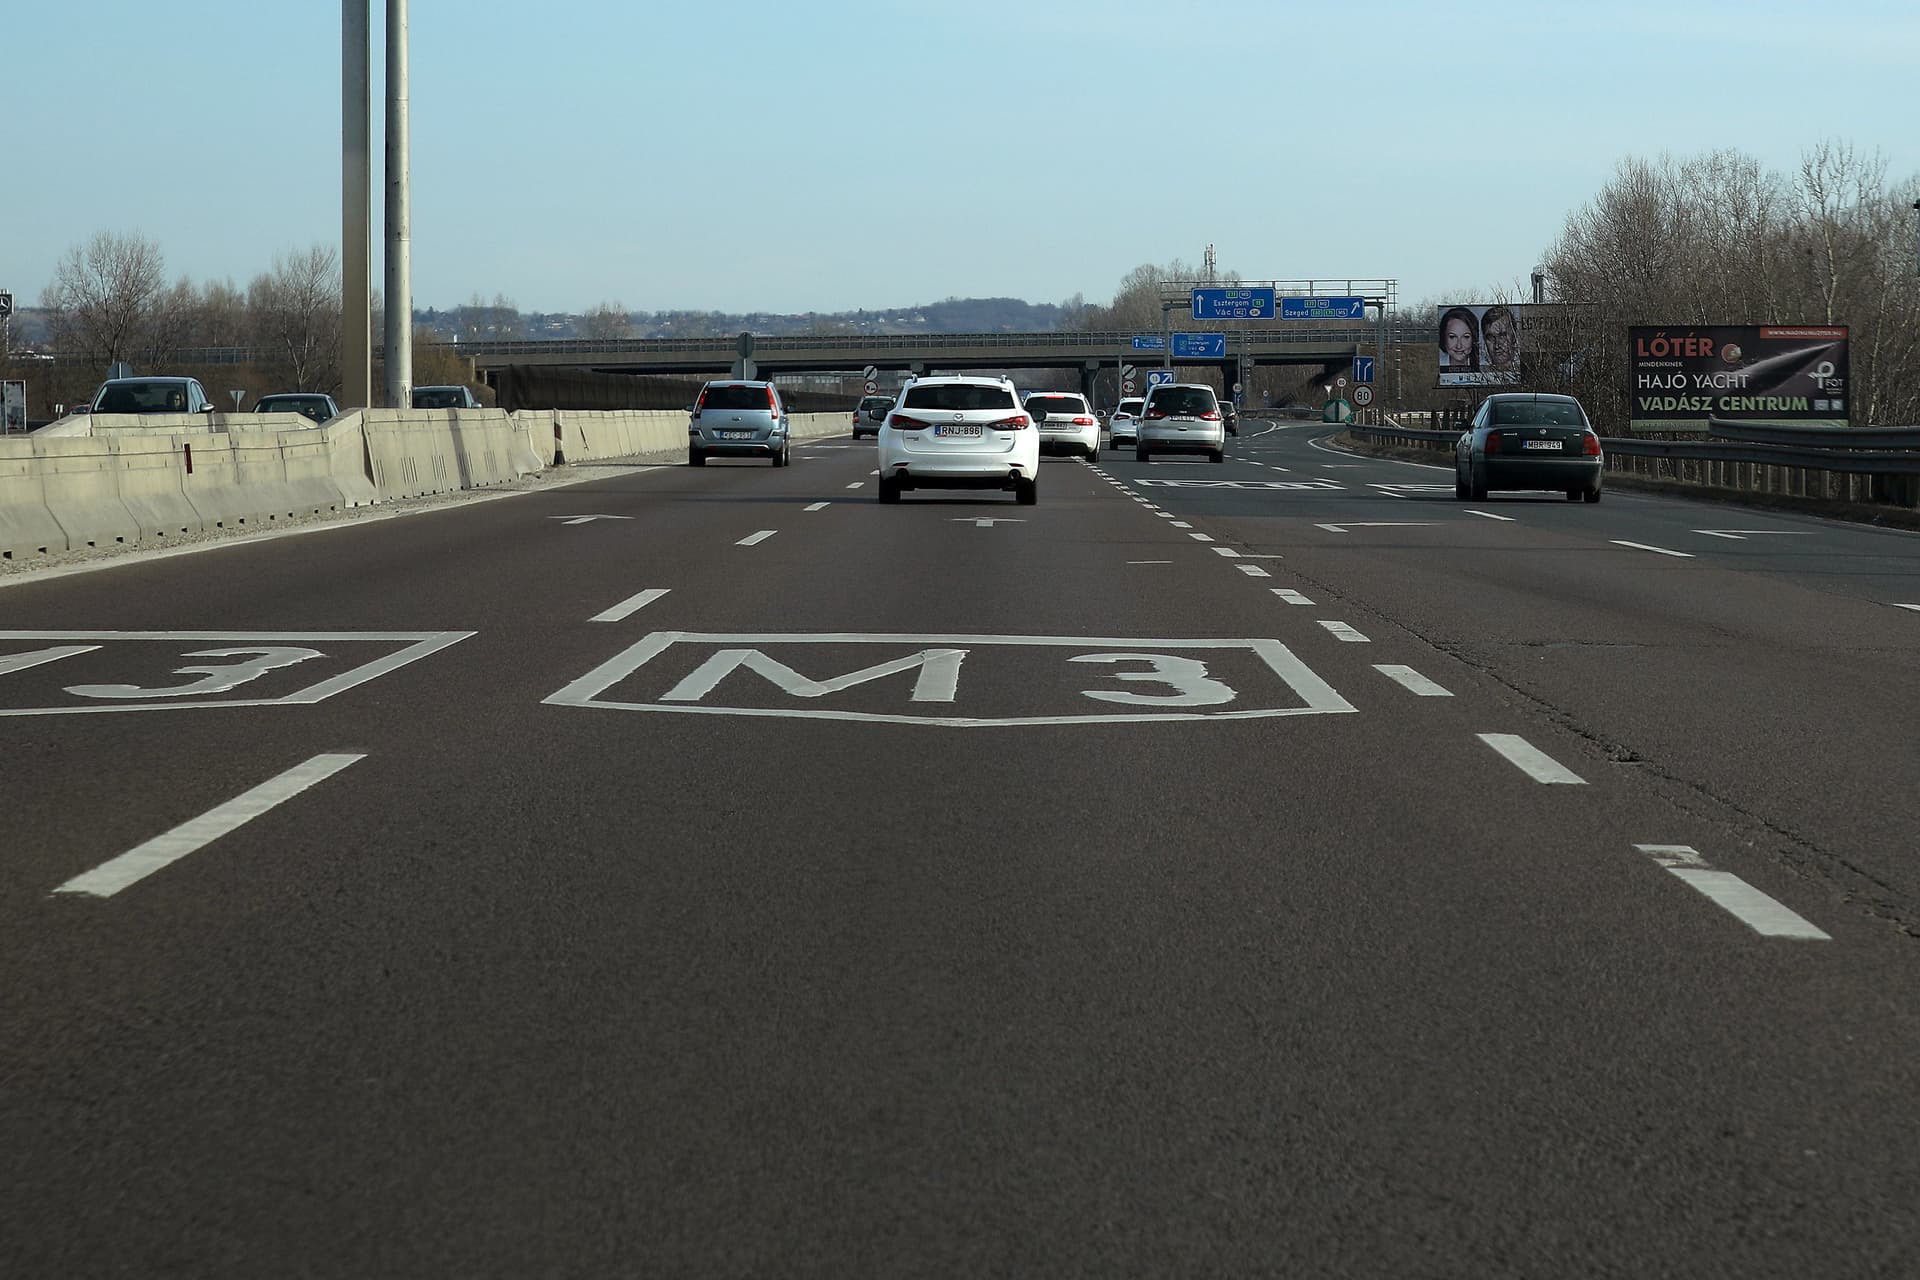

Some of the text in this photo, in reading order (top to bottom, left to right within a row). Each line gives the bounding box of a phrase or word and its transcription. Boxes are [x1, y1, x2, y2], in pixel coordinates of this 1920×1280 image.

[1213, 299, 1249, 308] Esztergom
[1215, 308, 1232, 316] Vác
[1285, 310, 1309, 318] Szeged
[1637, 332, 1714, 357] LŐTÉR
[1638, 370, 1750, 389] HAJÓ YACHT
[1357, 391, 1369, 401] 80
[1638, 392, 1809, 411] VADÁSZ CENTRUM
[941, 425, 981, 435] RNJ-896
